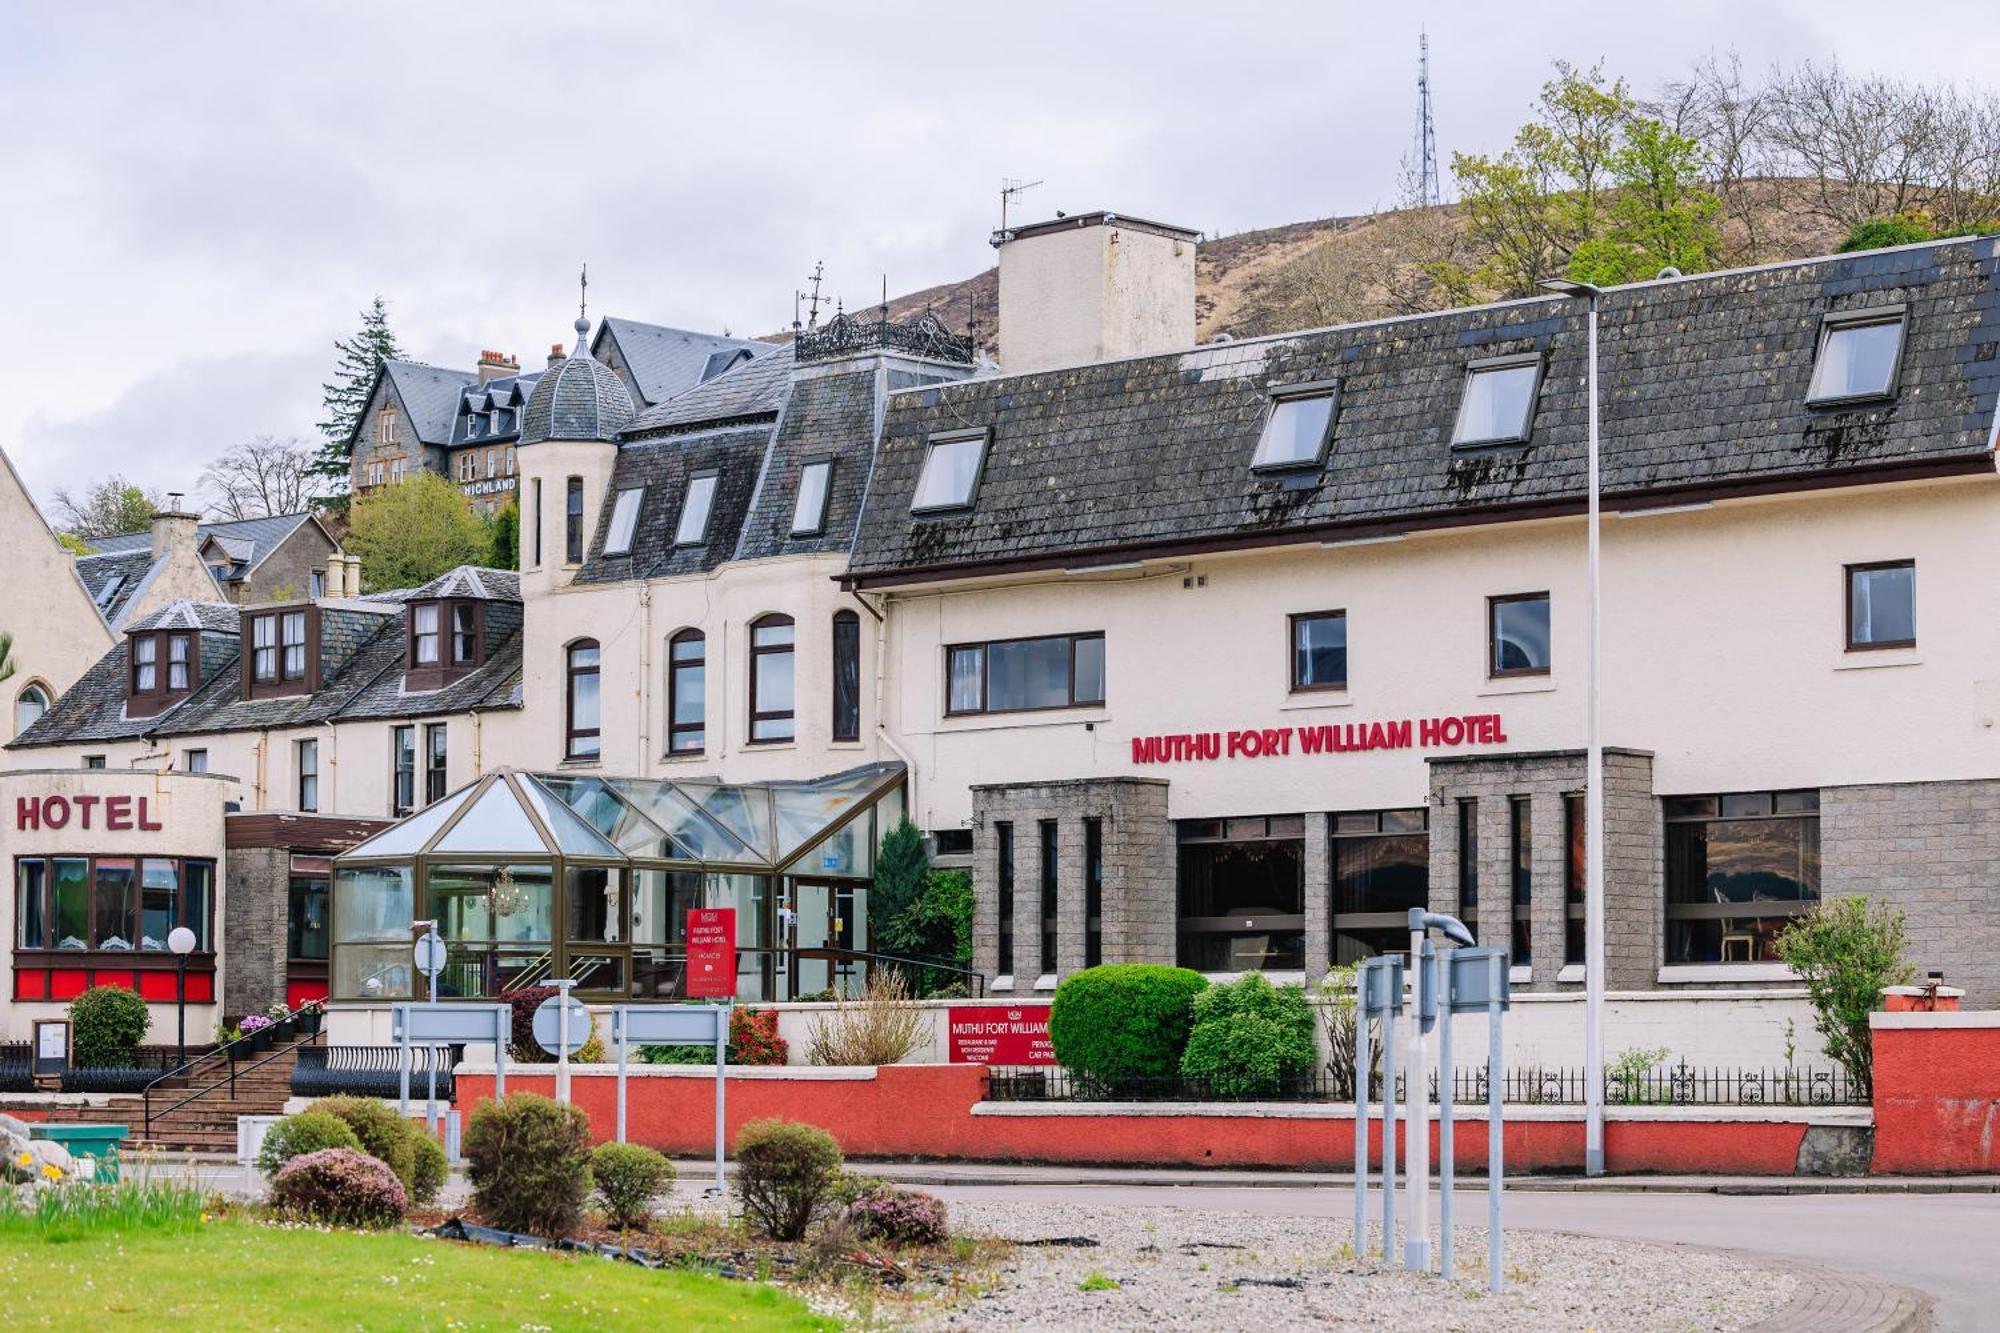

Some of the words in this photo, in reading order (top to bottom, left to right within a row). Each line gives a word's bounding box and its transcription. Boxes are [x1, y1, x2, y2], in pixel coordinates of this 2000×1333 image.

[464, 479, 516, 496] HIGHLAND
[1131, 732, 1221, 764] MUTHU
[1227, 727, 1293, 758] FORT
[1297, 720, 1412, 754] WILLIAM
[1419, 714, 1507, 747] HOTEL
[16, 795, 163, 831] HOTEL
[952, 1023, 984, 1035] MUTHU
[986, 1023, 1008, 1034] FORT
[1010, 1022, 1049, 1034] WILLIAM
[1028, 1051, 1042, 1059] CAR
